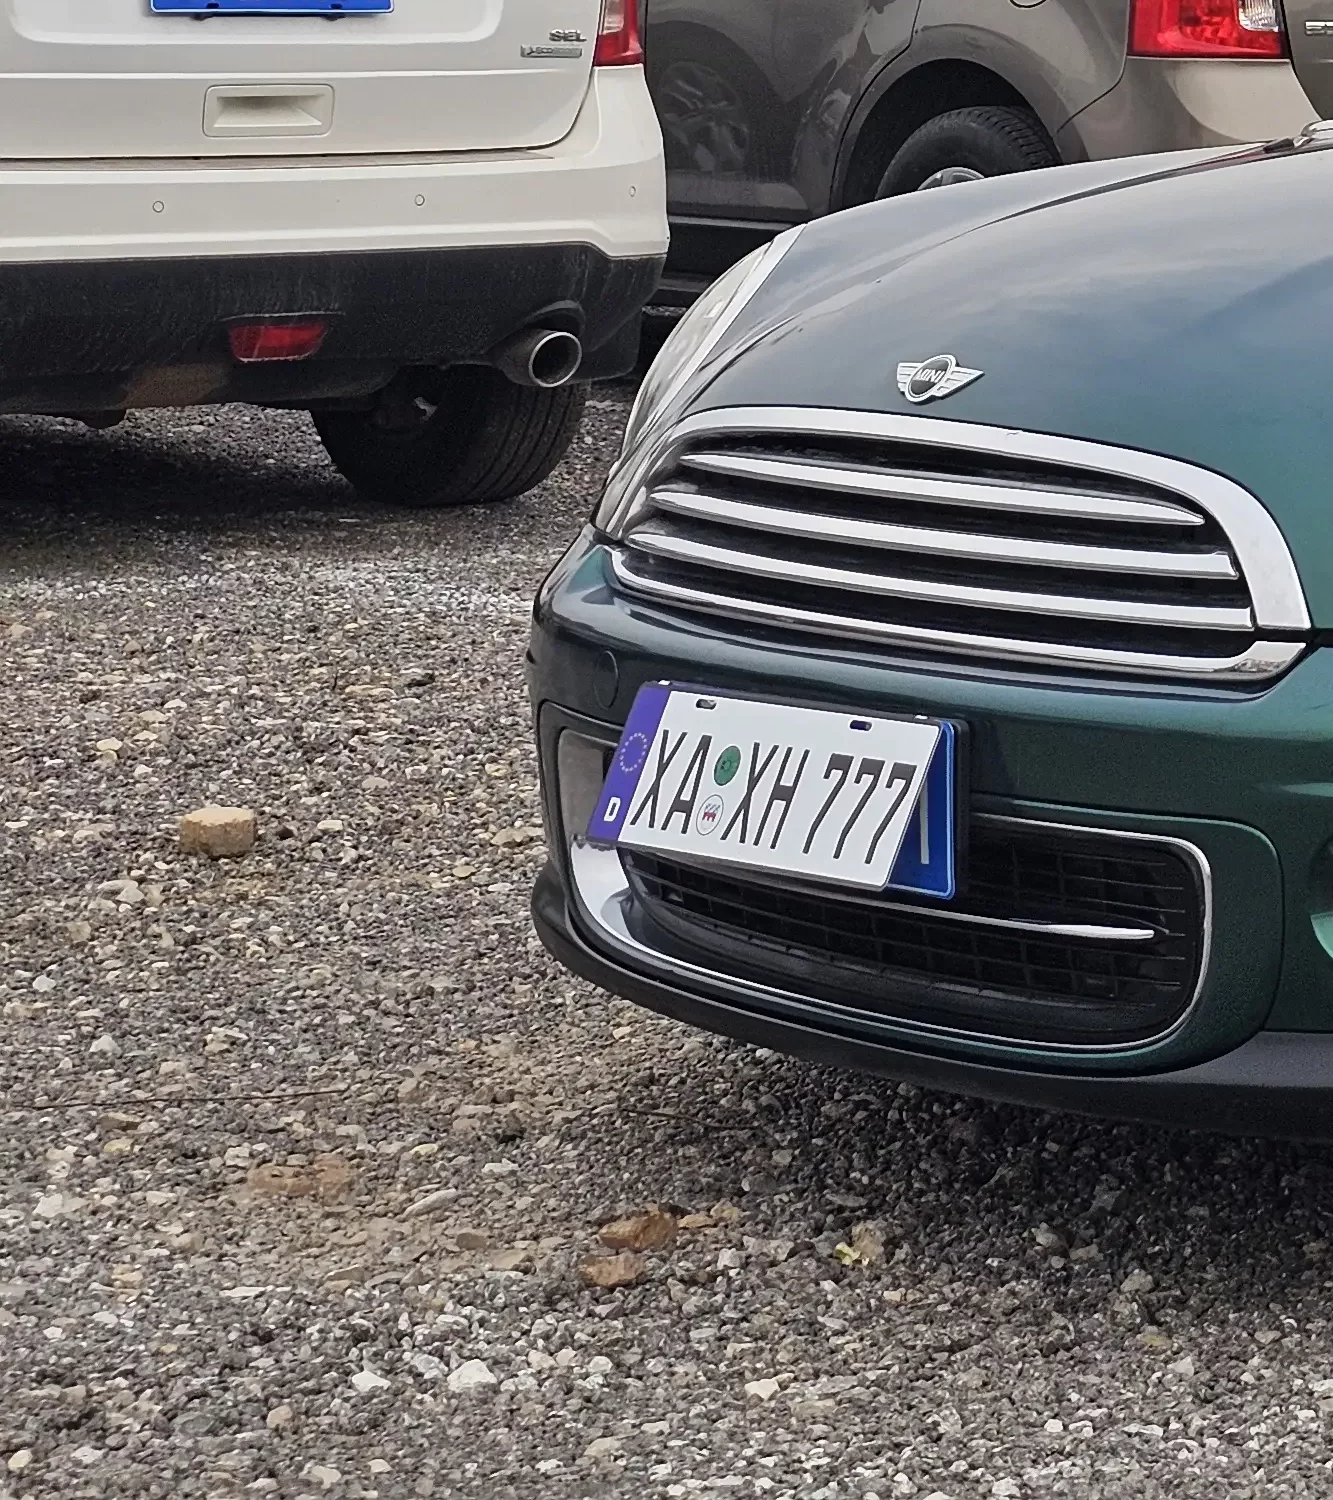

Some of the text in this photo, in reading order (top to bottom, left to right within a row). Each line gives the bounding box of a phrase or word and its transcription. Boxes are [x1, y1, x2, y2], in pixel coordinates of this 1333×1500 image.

[548, 28, 587, 42] SEL
[603, 796, 621, 822] D
[629, 728, 713, 835] XA
[719, 741, 811, 850] XH
[802, 752, 918, 865] 777
